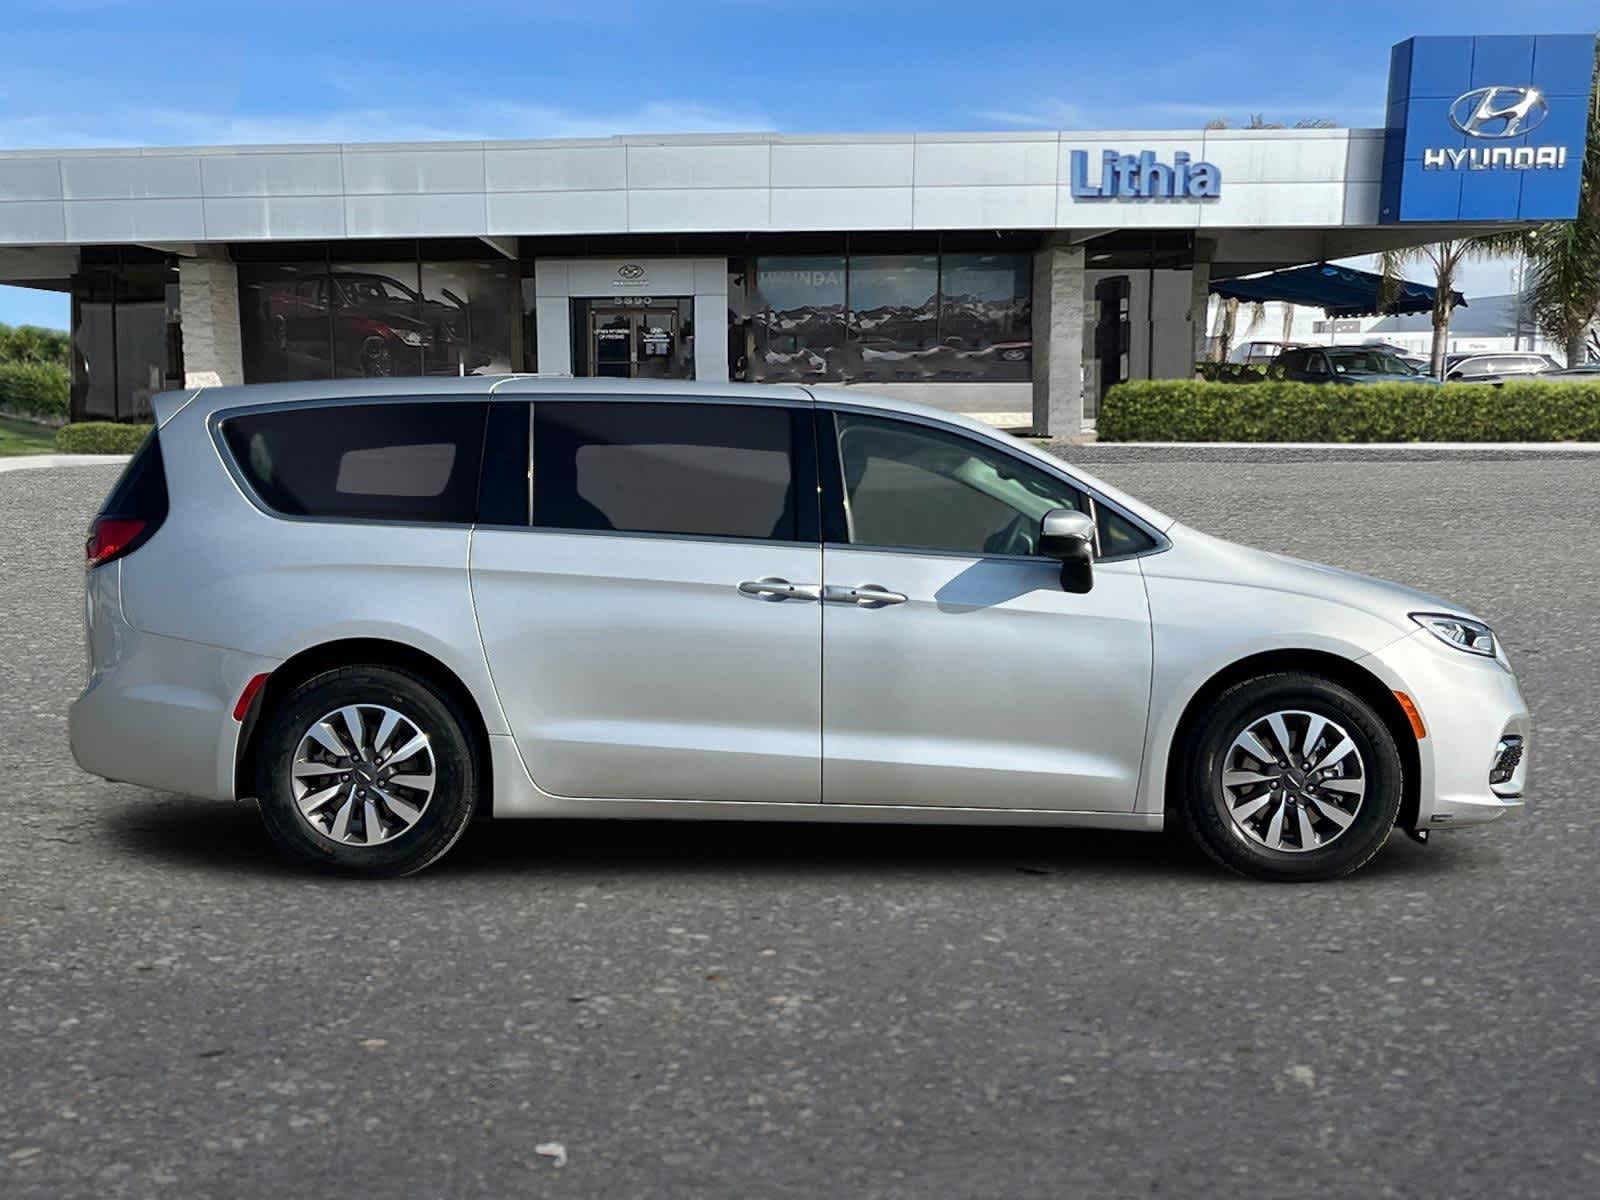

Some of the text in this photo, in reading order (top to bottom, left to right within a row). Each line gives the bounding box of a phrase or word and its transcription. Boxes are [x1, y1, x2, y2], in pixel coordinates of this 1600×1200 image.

[1423, 146, 1568, 171] HYUNDAI
[1070, 150, 1221, 201] Lithia
[759, 271, 842, 288] NDAI
